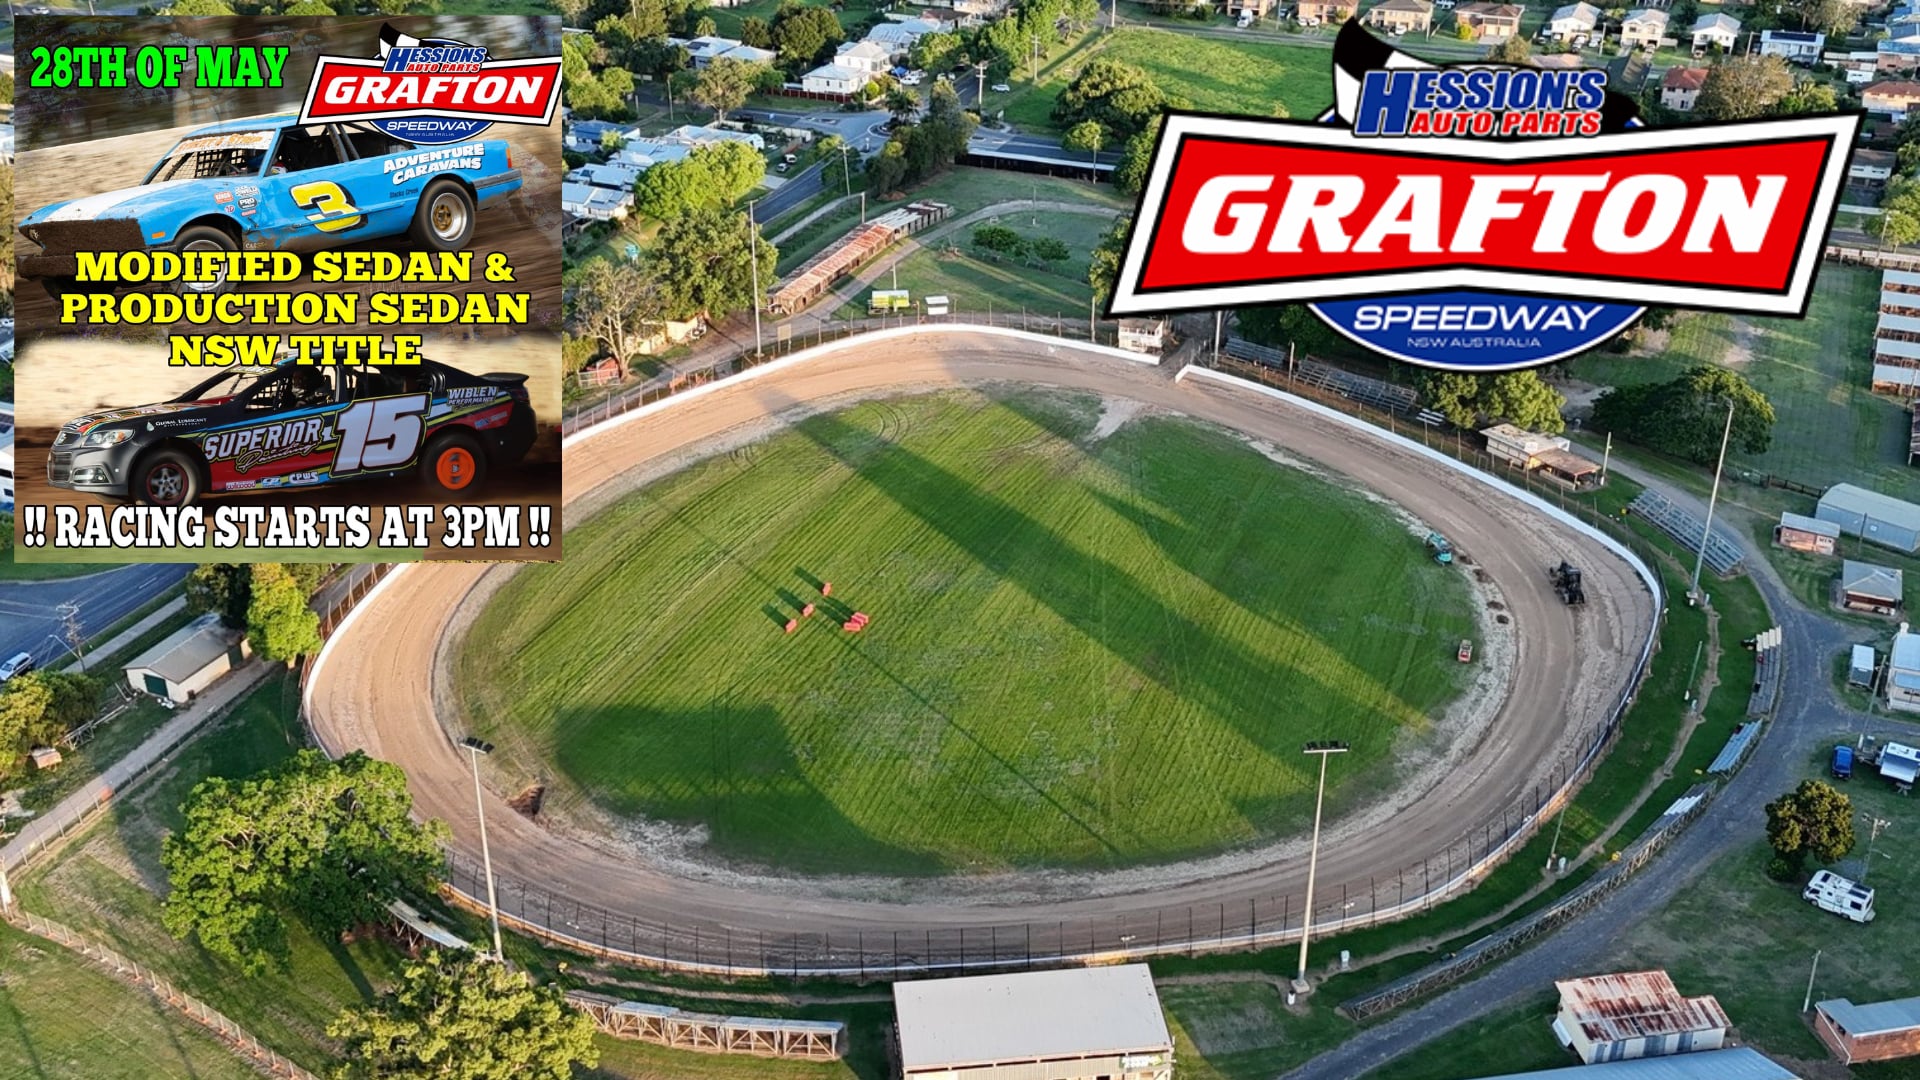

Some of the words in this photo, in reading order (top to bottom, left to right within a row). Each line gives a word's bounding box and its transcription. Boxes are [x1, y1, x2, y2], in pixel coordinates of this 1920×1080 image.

[383, 143, 485, 174] ADVENTURE
[392, 158, 482, 185] CARAVANS
[290, 180, 366, 234] 3
[448, 386, 497, 400] WIBLEN
[205, 418, 322, 459] SUPERIOR
[334, 397, 427, 472] 15
